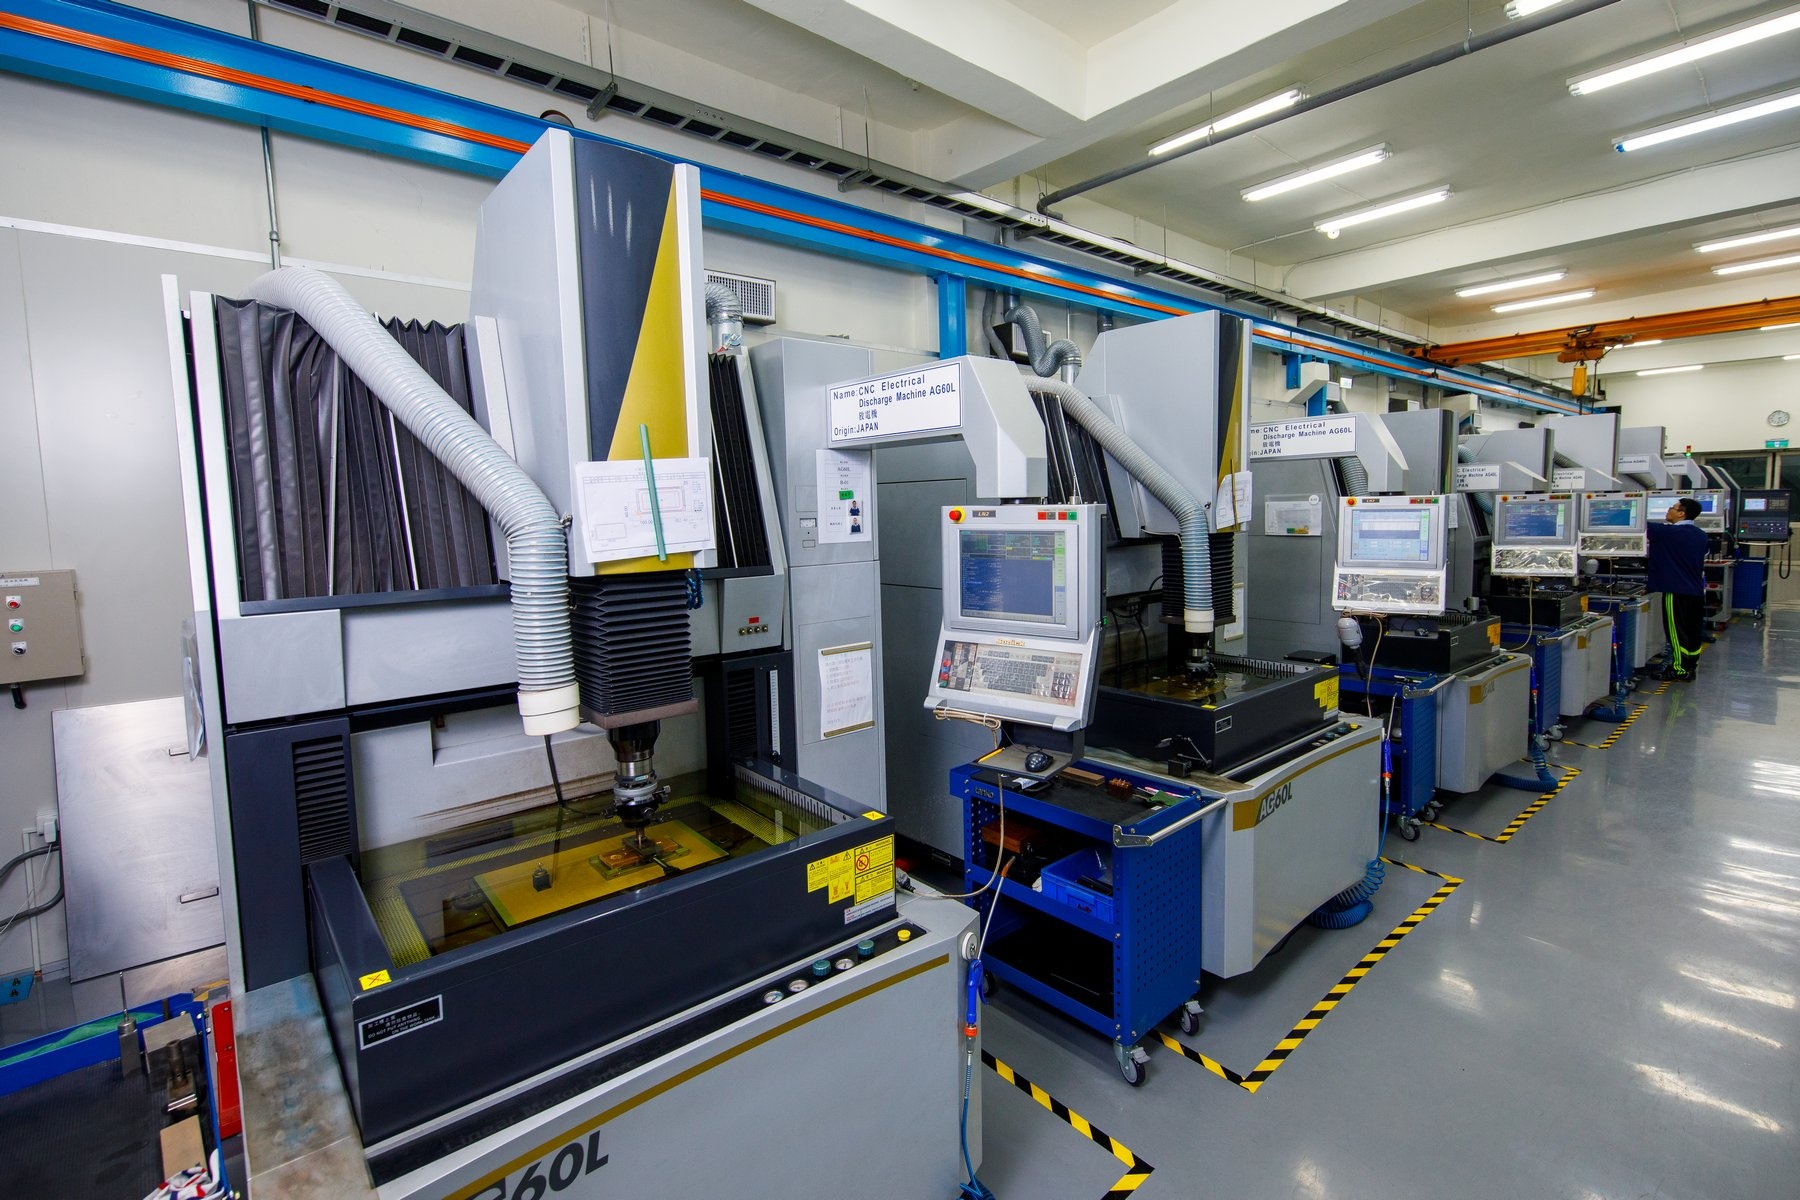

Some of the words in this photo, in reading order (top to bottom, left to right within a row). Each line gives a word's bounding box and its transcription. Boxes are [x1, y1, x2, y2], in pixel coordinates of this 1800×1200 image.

[881, 374, 925, 391] Electrical
[858, 395, 893, 408] Discharge
[895, 388, 926, 401] Machine
[929, 383, 956, 396] AG60L
[858, 409, 878, 420] 放電機
[834, 422, 879, 437] Origin:JAPAN
[1285, 422, 1326, 431] Electrical
[1298, 429, 1327, 437] Machine
[1328, 426, 1353, 434] AG60L
[1258, 782, 1293, 822] AG60L
